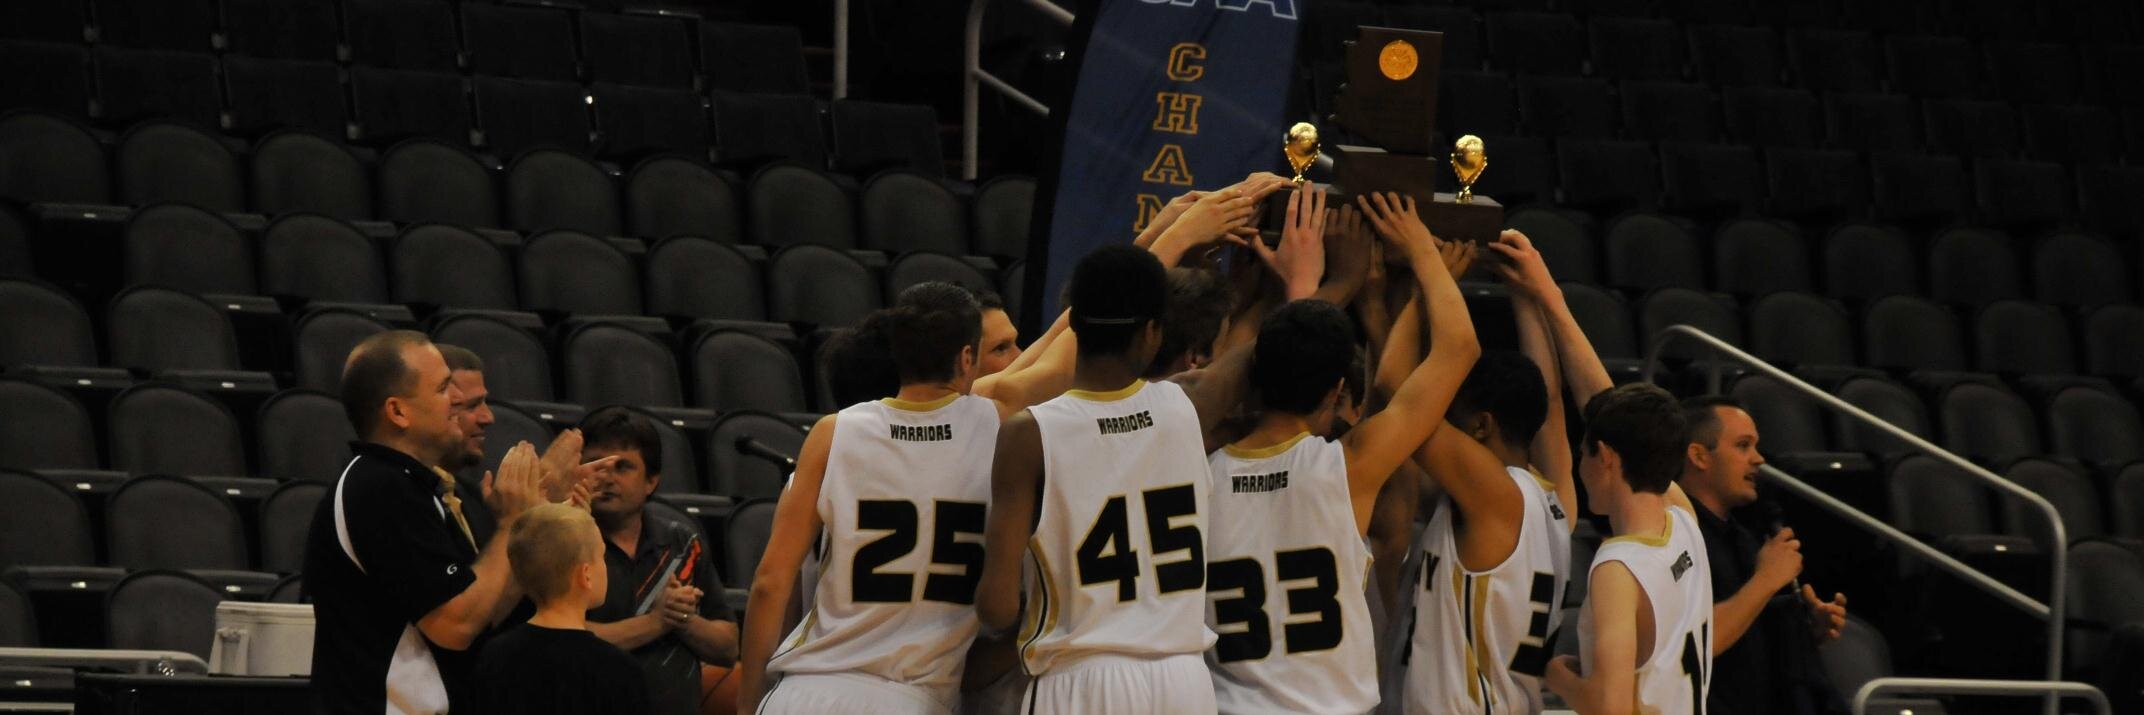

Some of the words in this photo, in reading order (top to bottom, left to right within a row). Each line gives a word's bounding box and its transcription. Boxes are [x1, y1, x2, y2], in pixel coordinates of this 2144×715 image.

[890, 423, 952, 442] WARRIORS
[1096, 410, 1154, 435] WARRIORS
[1231, 471, 1289, 493] WARRIORS
[852, 499, 986, 604] 25
[1077, 484, 1205, 602] 45
[1206, 547, 1342, 662] 33
